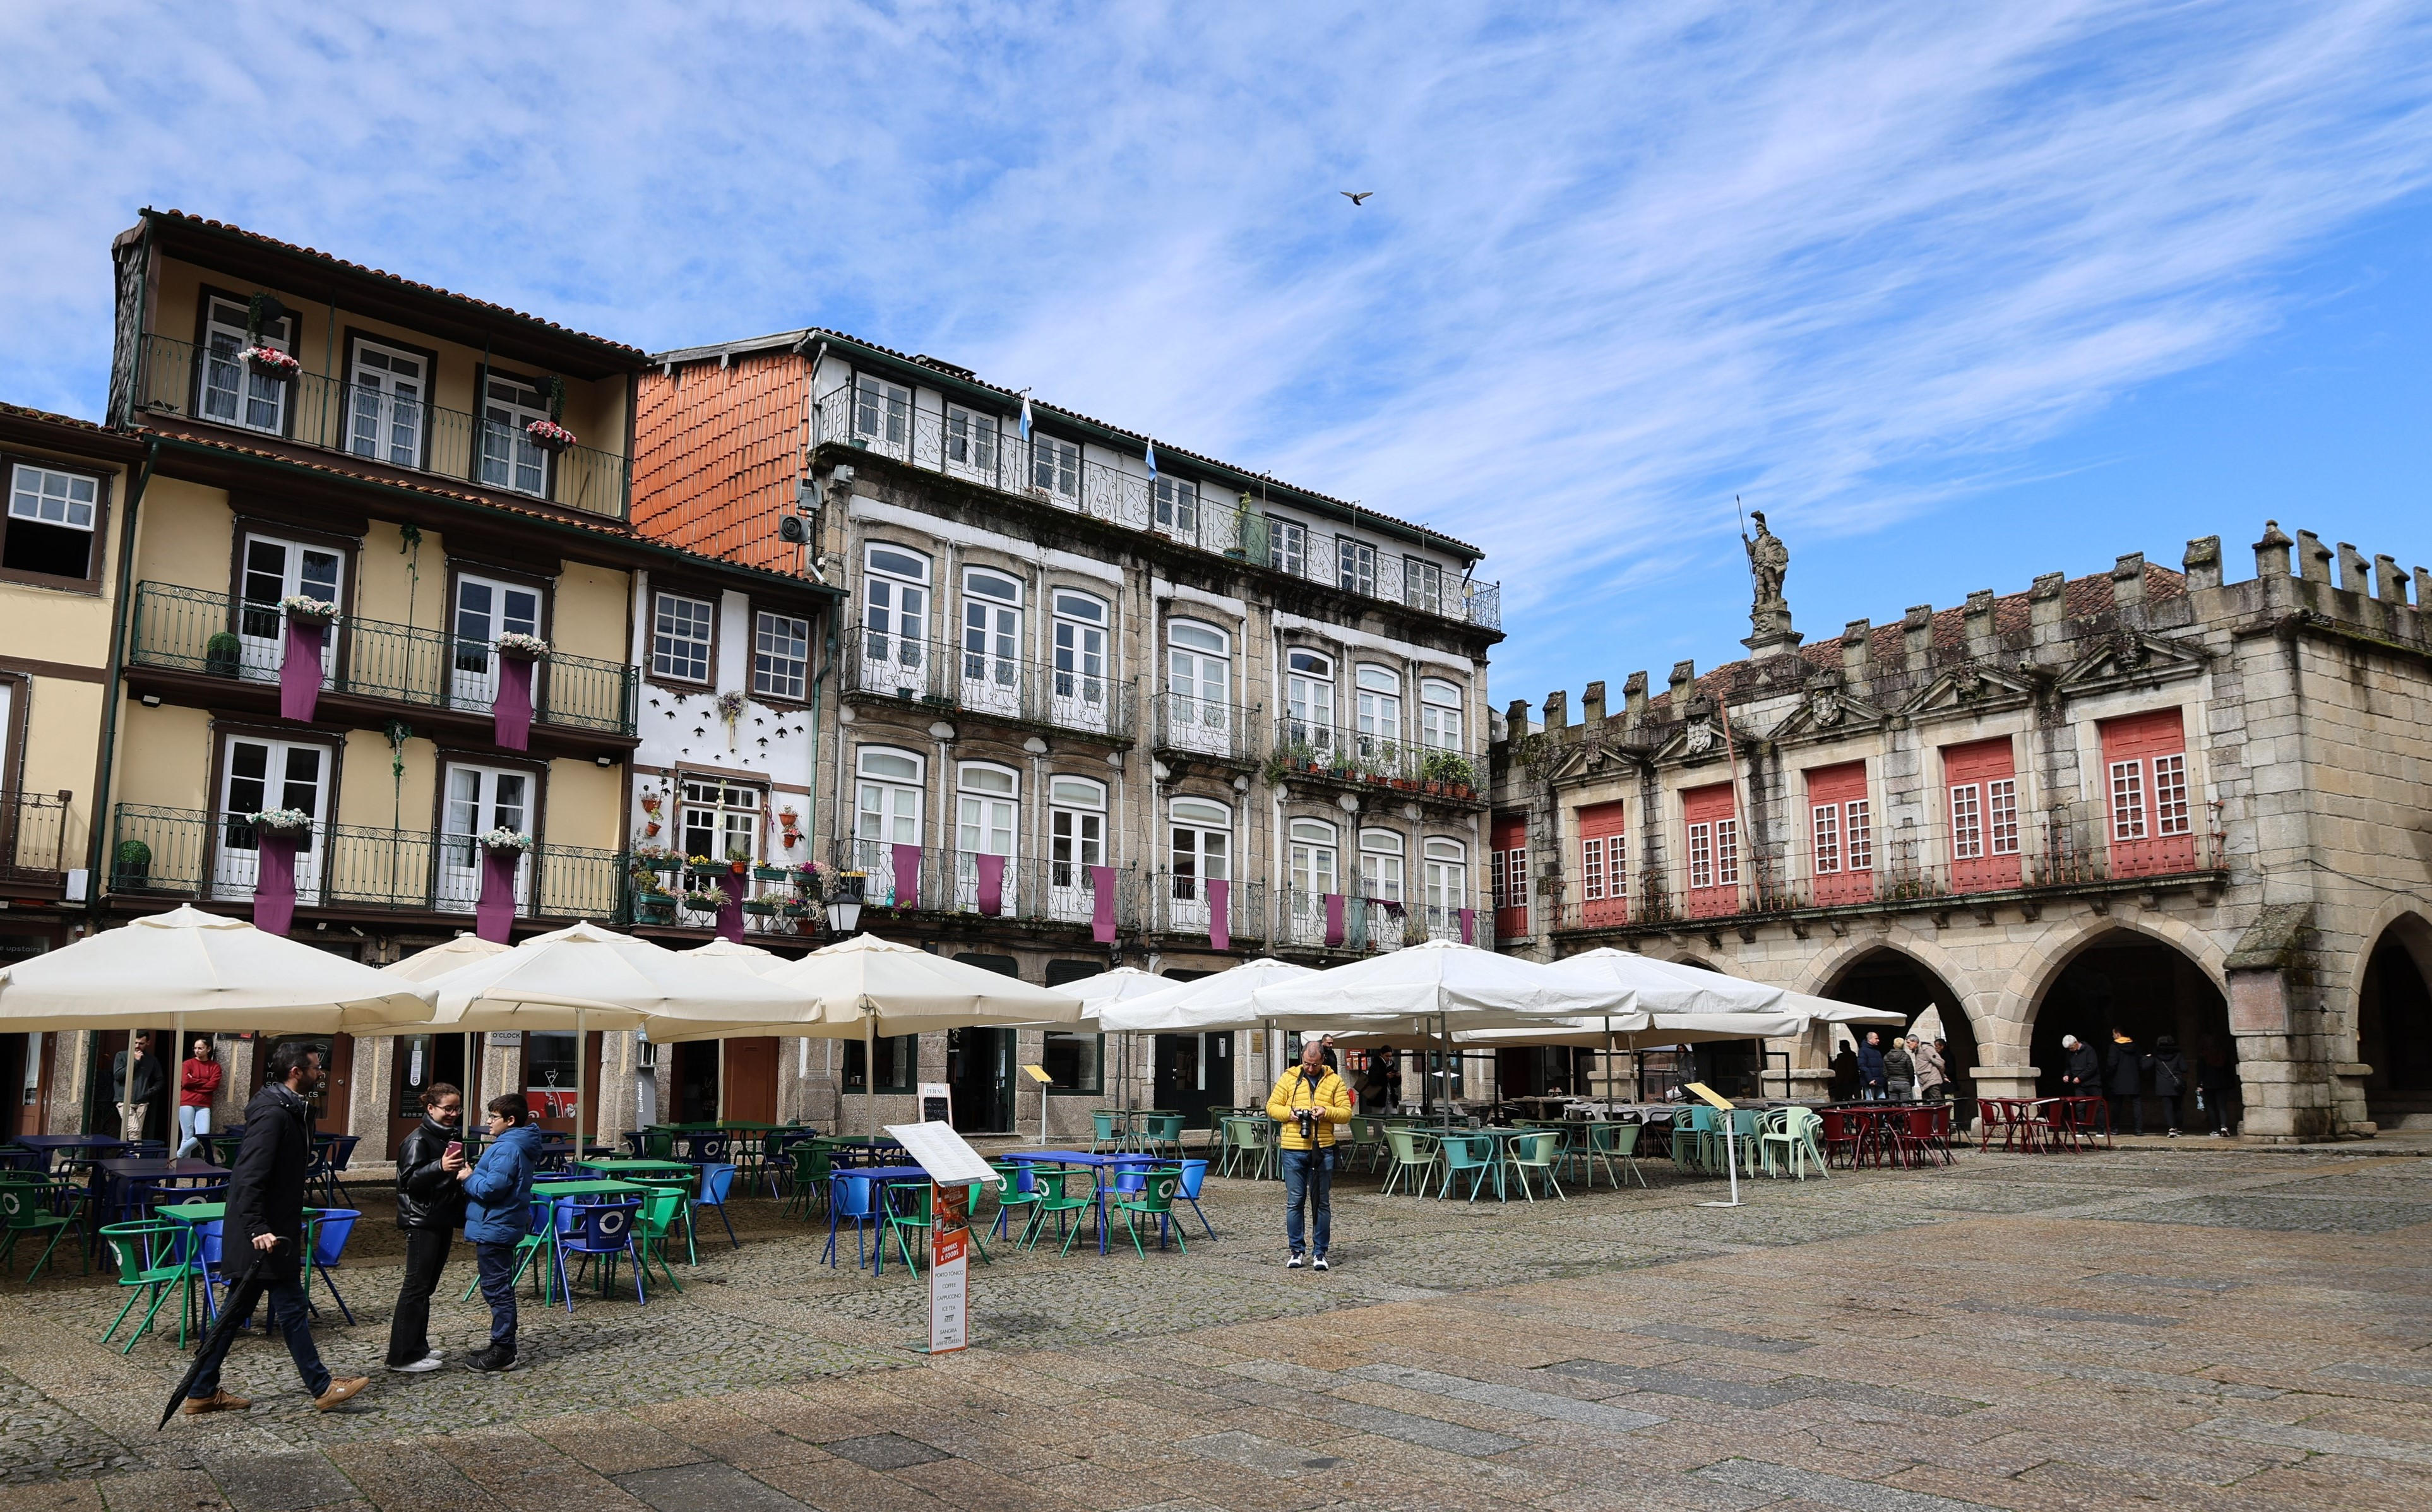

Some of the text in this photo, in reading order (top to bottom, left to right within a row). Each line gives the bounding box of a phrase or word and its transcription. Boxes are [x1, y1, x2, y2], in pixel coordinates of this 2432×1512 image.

[942, 1242, 958, 1254] DRINKS
[945, 1249, 959, 1260] FOODS
[936, 1293, 962, 1301] CAPPUCCINO
